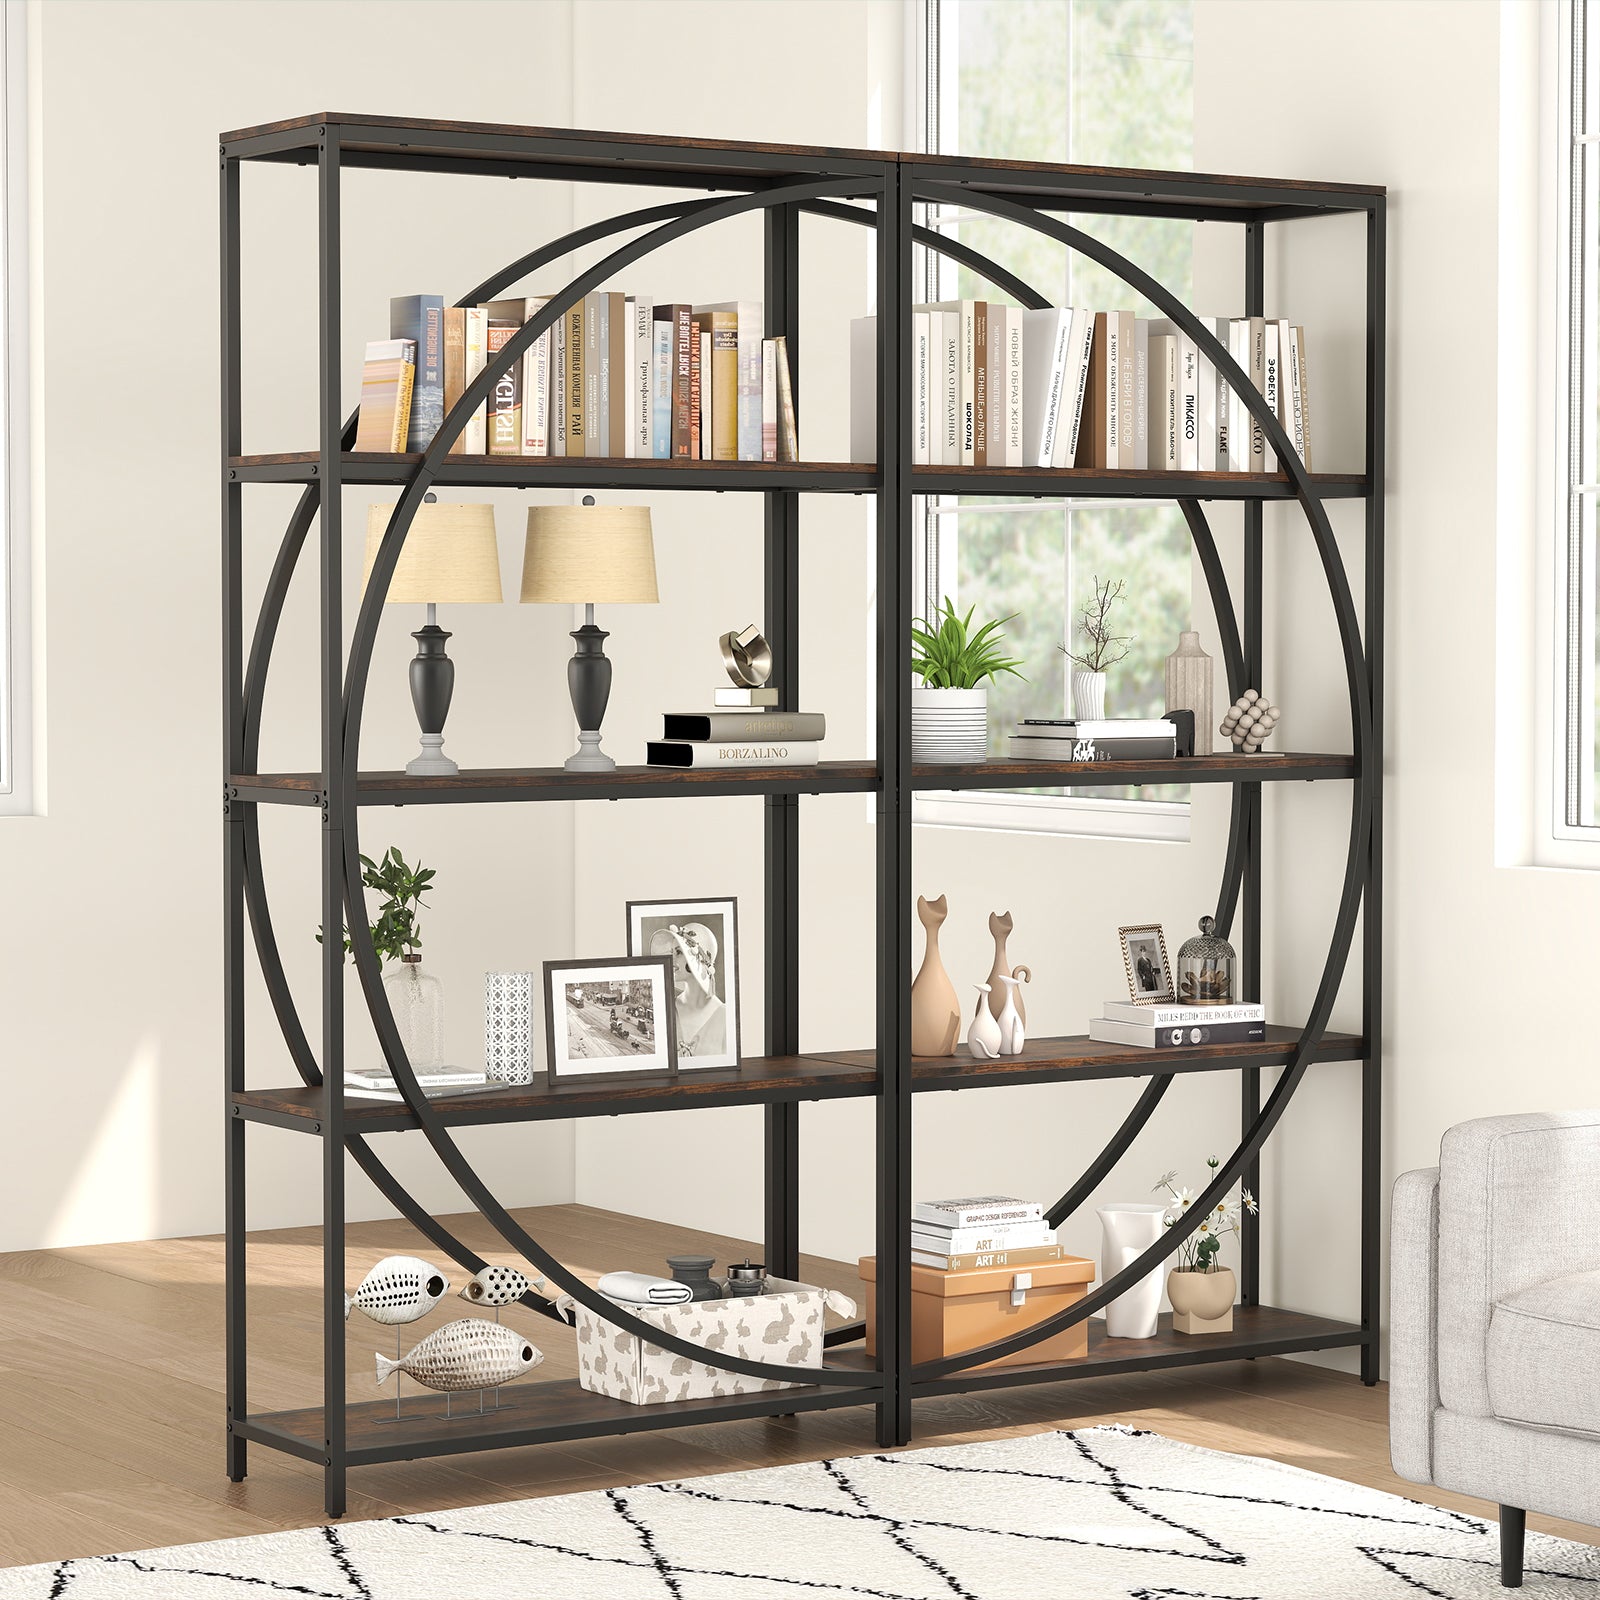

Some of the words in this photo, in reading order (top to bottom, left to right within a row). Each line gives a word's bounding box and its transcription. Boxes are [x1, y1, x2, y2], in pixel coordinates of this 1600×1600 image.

[572, 314, 581, 371] БОЖЕСТВЕННАЯ
[948, 339, 956, 374] ЗАБОТА
[1011, 328, 1020, 367] НОВЫЙ
[1124, 357, 1132, 370] НЕ
[1137, 350, 1145, 375] ДАВИД
[572, 373, 581, 408] КОМЕДИЯ
[640, 360, 649, 424] Триумфальная
[1011, 370, 1019, 404] ОБРАЗ
[1078, 365, 1088, 393] Религия
[1124, 372, 1132, 398] БЕРИ
[947, 387, 956, 447] ПРЕДАННЫХ
[1075, 394, 1083, 421] черной
[1185, 395, 1195, 440] ПИКАССО
[572, 414, 583, 436] РАЙ
[640, 426, 648, 446] арка
[1011, 408, 1019, 448] ЖИЗНИ
[1070, 422, 1079, 455] водолазки
[1123, 409, 1132, 448] ГОЛОВУ
[1293, 390, 1304, 457] НЬЮ-ЙОРК
[719, 748, 788, 759] BORZALINO
[1157, 1013, 1179, 1023] MILES
[1199, 1011, 1213, 1020] THE
[1214, 1010, 1233, 1020] BOOK
[1234, 1010, 1243, 1019] OF
[1244, 1008, 1261, 1018] CHIC
[966, 1214, 985, 1223] GRAPHIC
[976, 1240, 993, 1251] ART
[976, 1255, 994, 1267] ART
